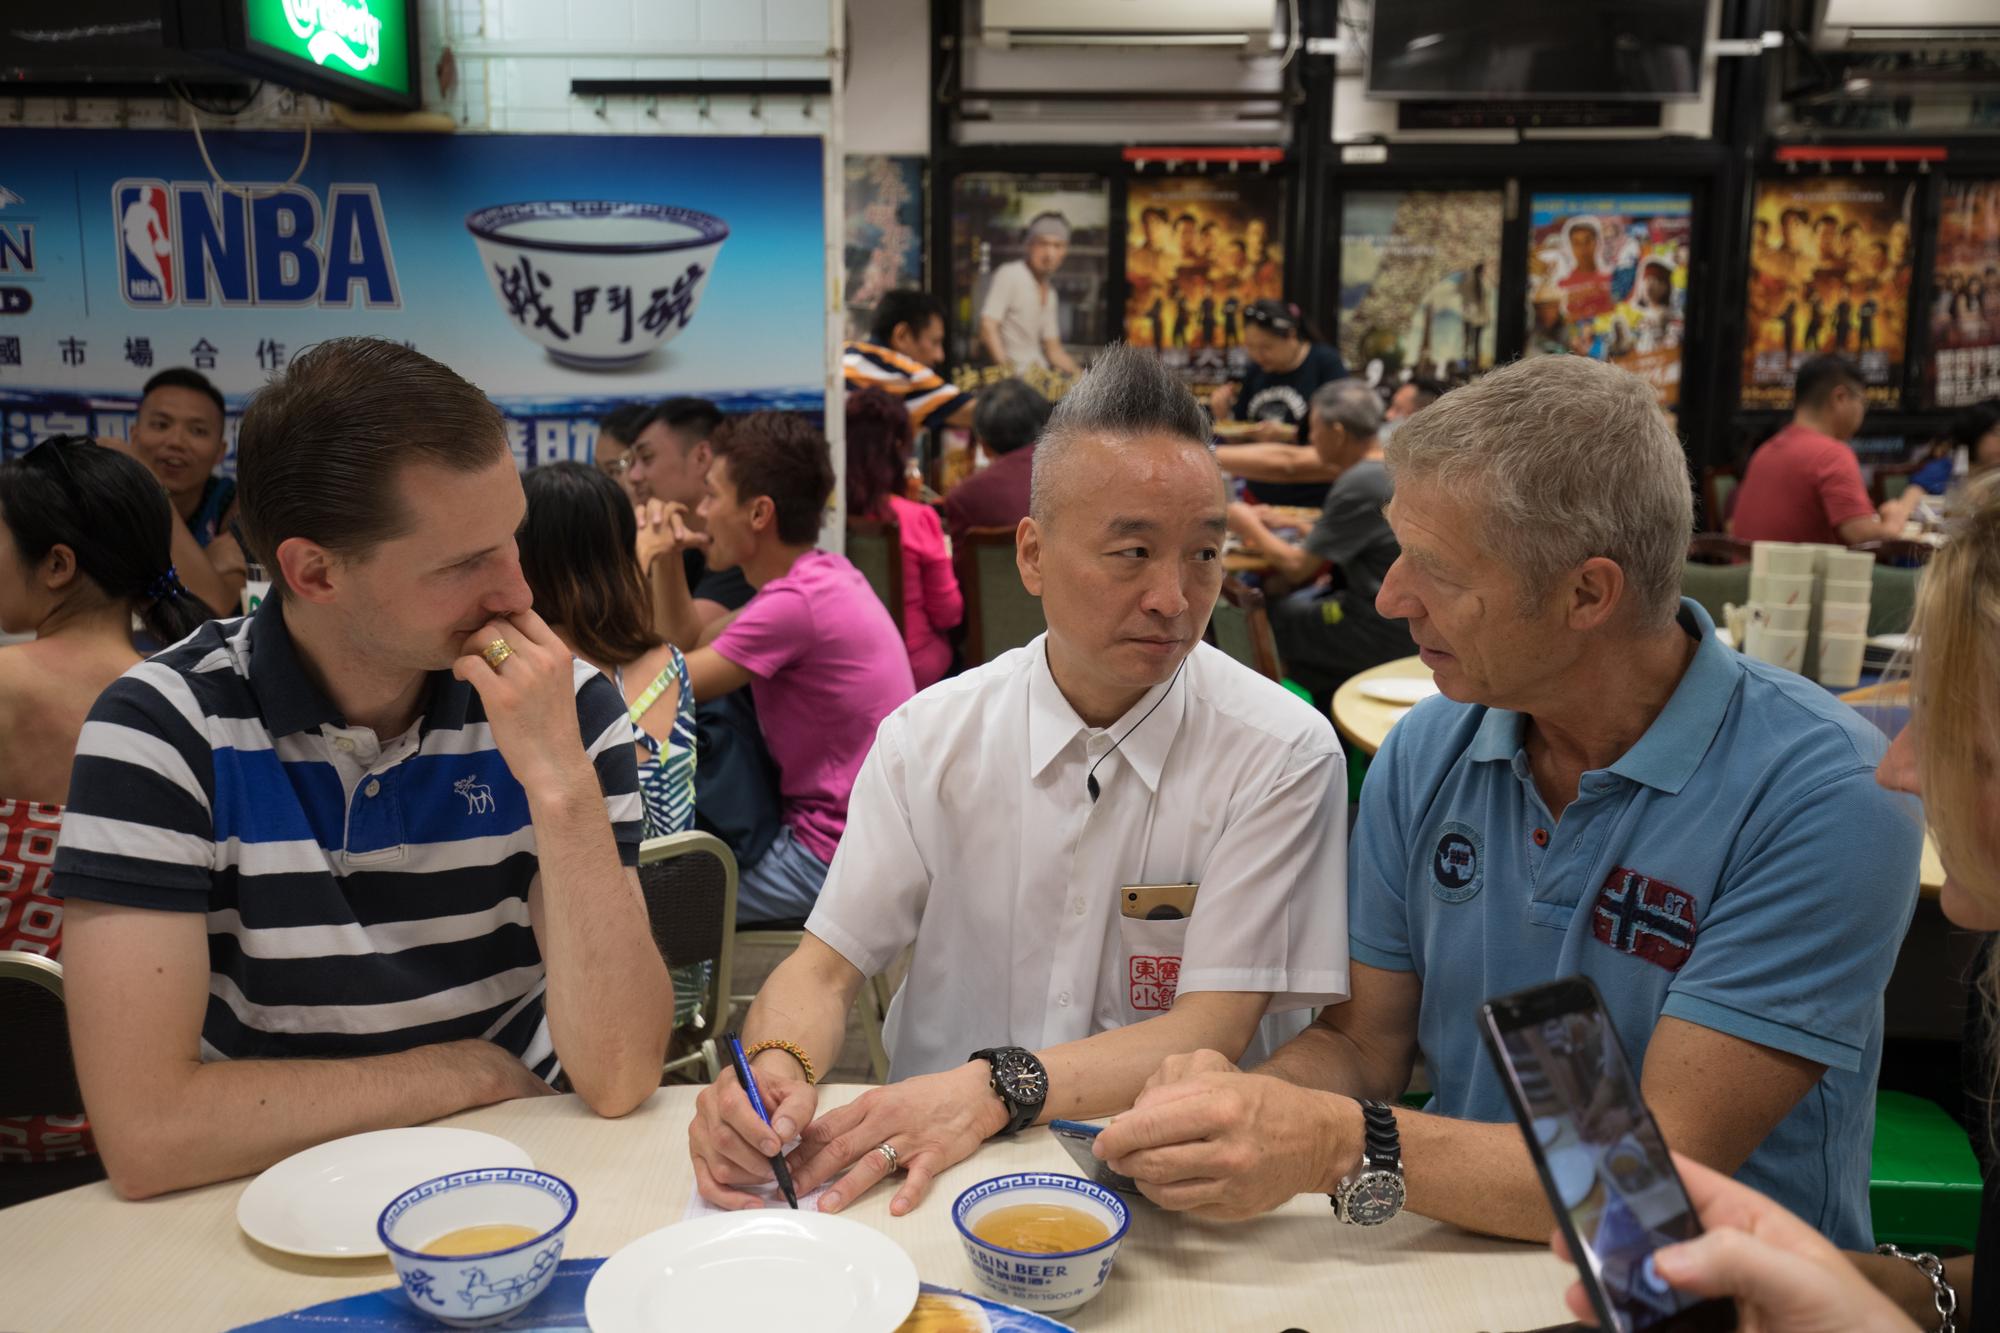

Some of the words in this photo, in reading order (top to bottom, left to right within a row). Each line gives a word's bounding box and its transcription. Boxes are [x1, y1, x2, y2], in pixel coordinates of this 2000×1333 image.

[173, 183, 400, 308] NBA
[130, 280, 161, 298] NBA
[1015, 1263, 1068, 1277] BEER
